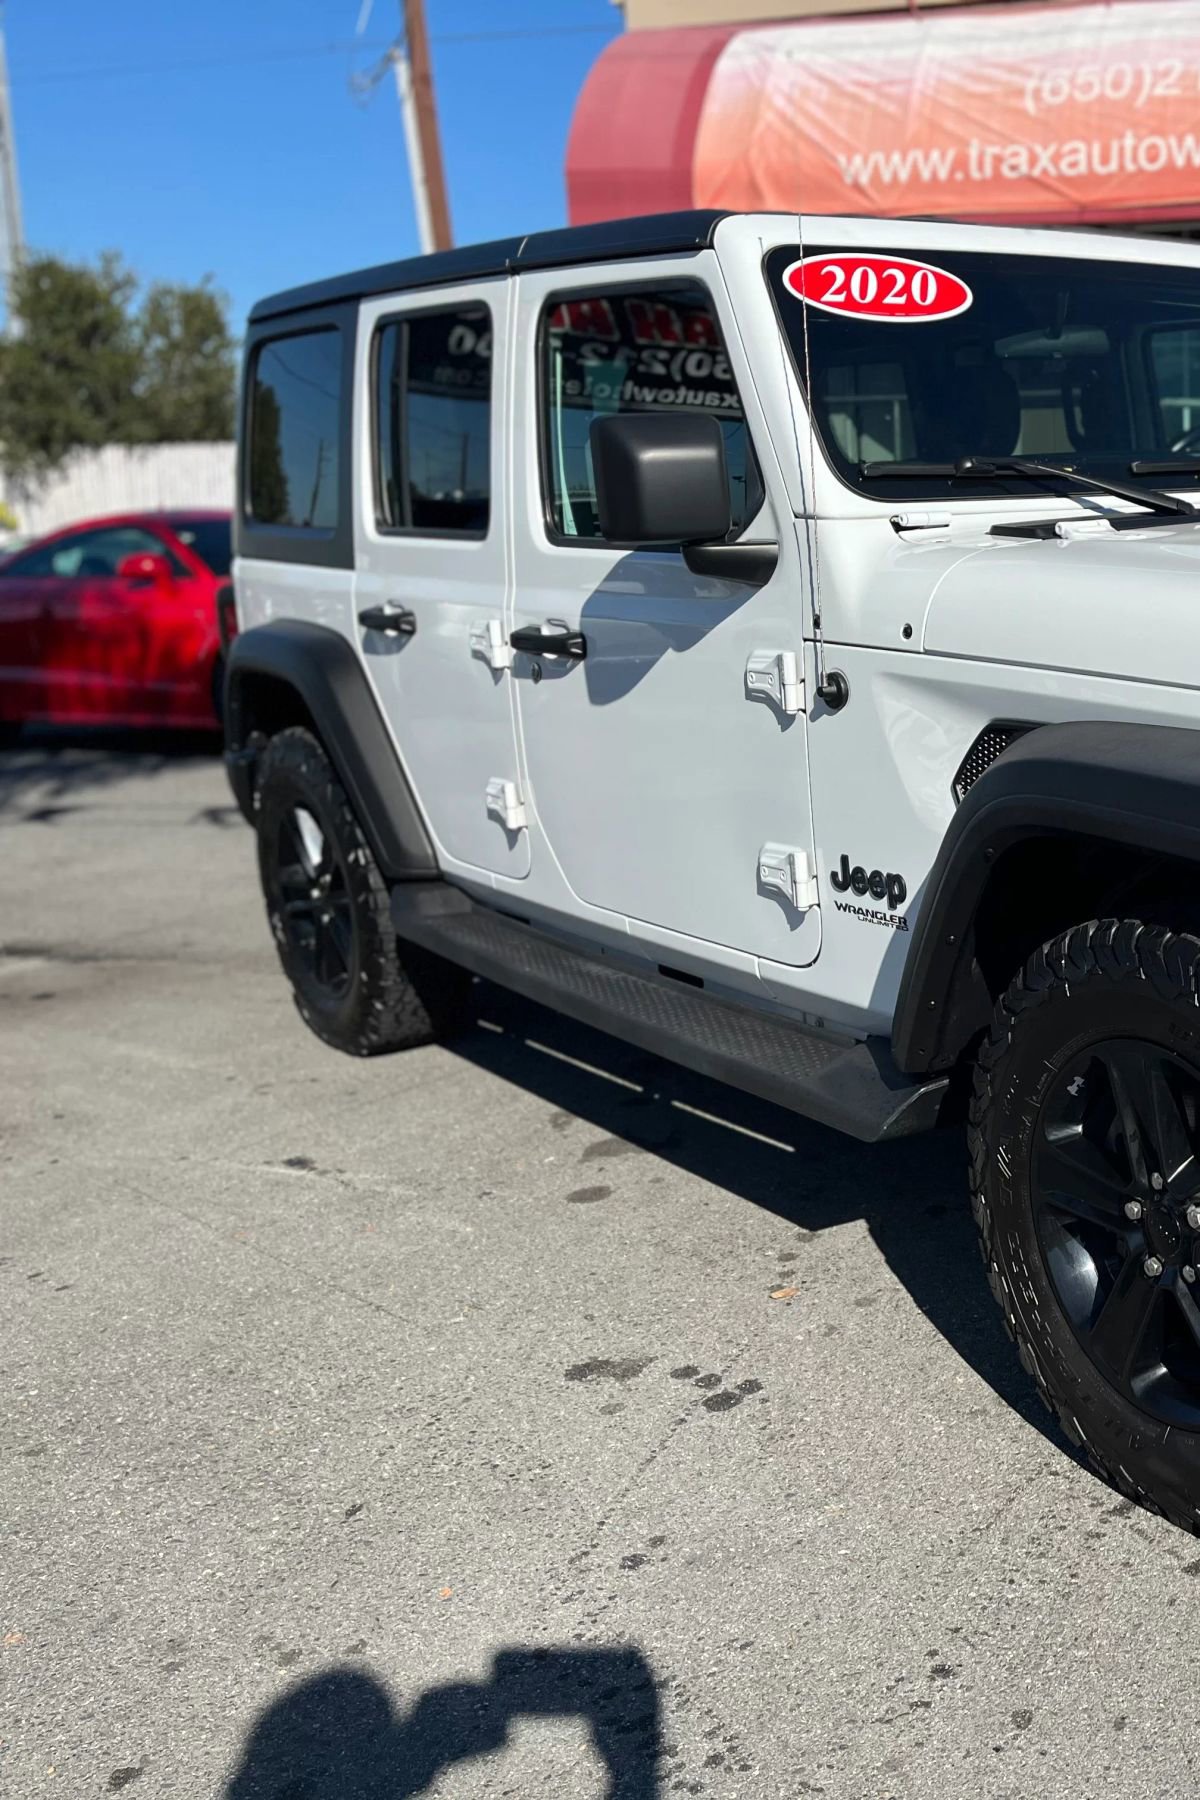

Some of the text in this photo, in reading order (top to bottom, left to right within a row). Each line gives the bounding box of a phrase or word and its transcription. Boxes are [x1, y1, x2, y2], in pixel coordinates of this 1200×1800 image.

[819, 264, 938, 306] 2020
[830, 853, 907, 912] Jeep
[833, 899, 908, 927] WRANGLER
[856, 915, 909, 932] UNLIMITED
